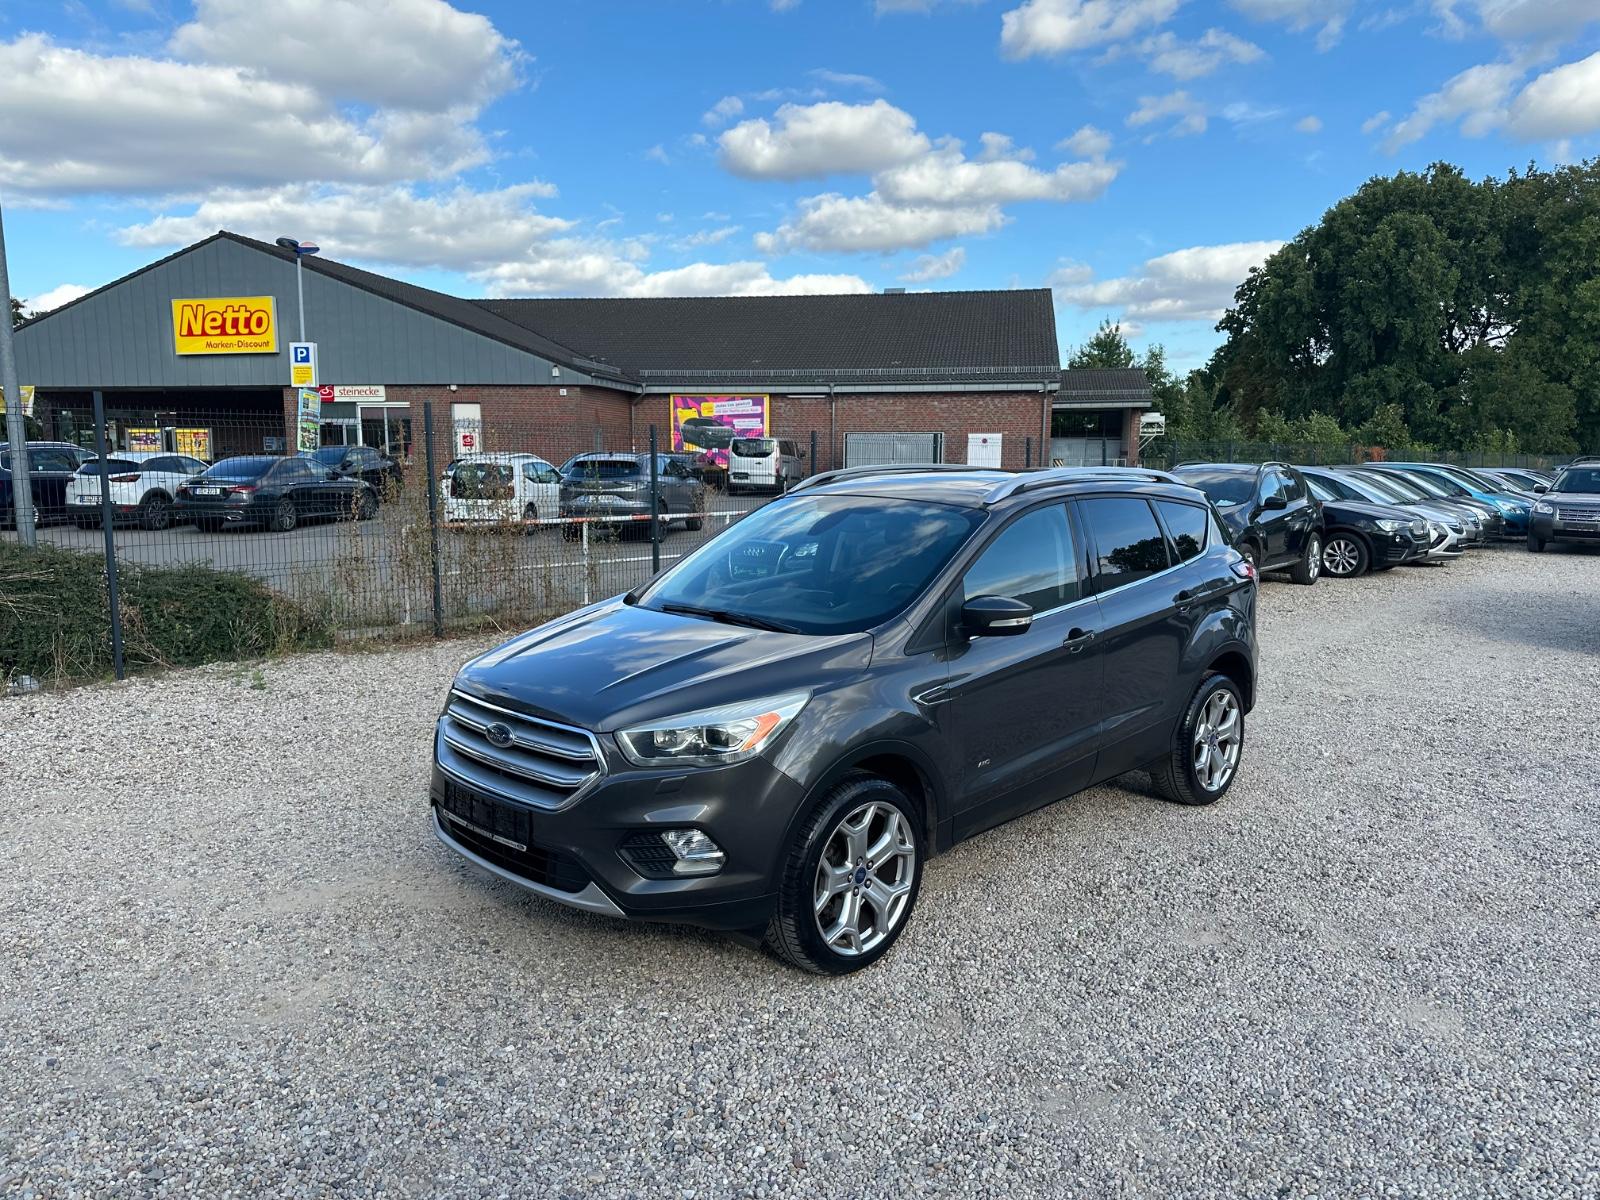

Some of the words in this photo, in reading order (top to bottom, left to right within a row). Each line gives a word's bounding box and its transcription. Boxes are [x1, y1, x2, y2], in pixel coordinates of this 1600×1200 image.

[180, 304, 270, 337] Netto
[205, 340, 270, 349] Marken-Discount
[297, 347, 307, 362] P
[338, 386, 380, 396] steinecke
